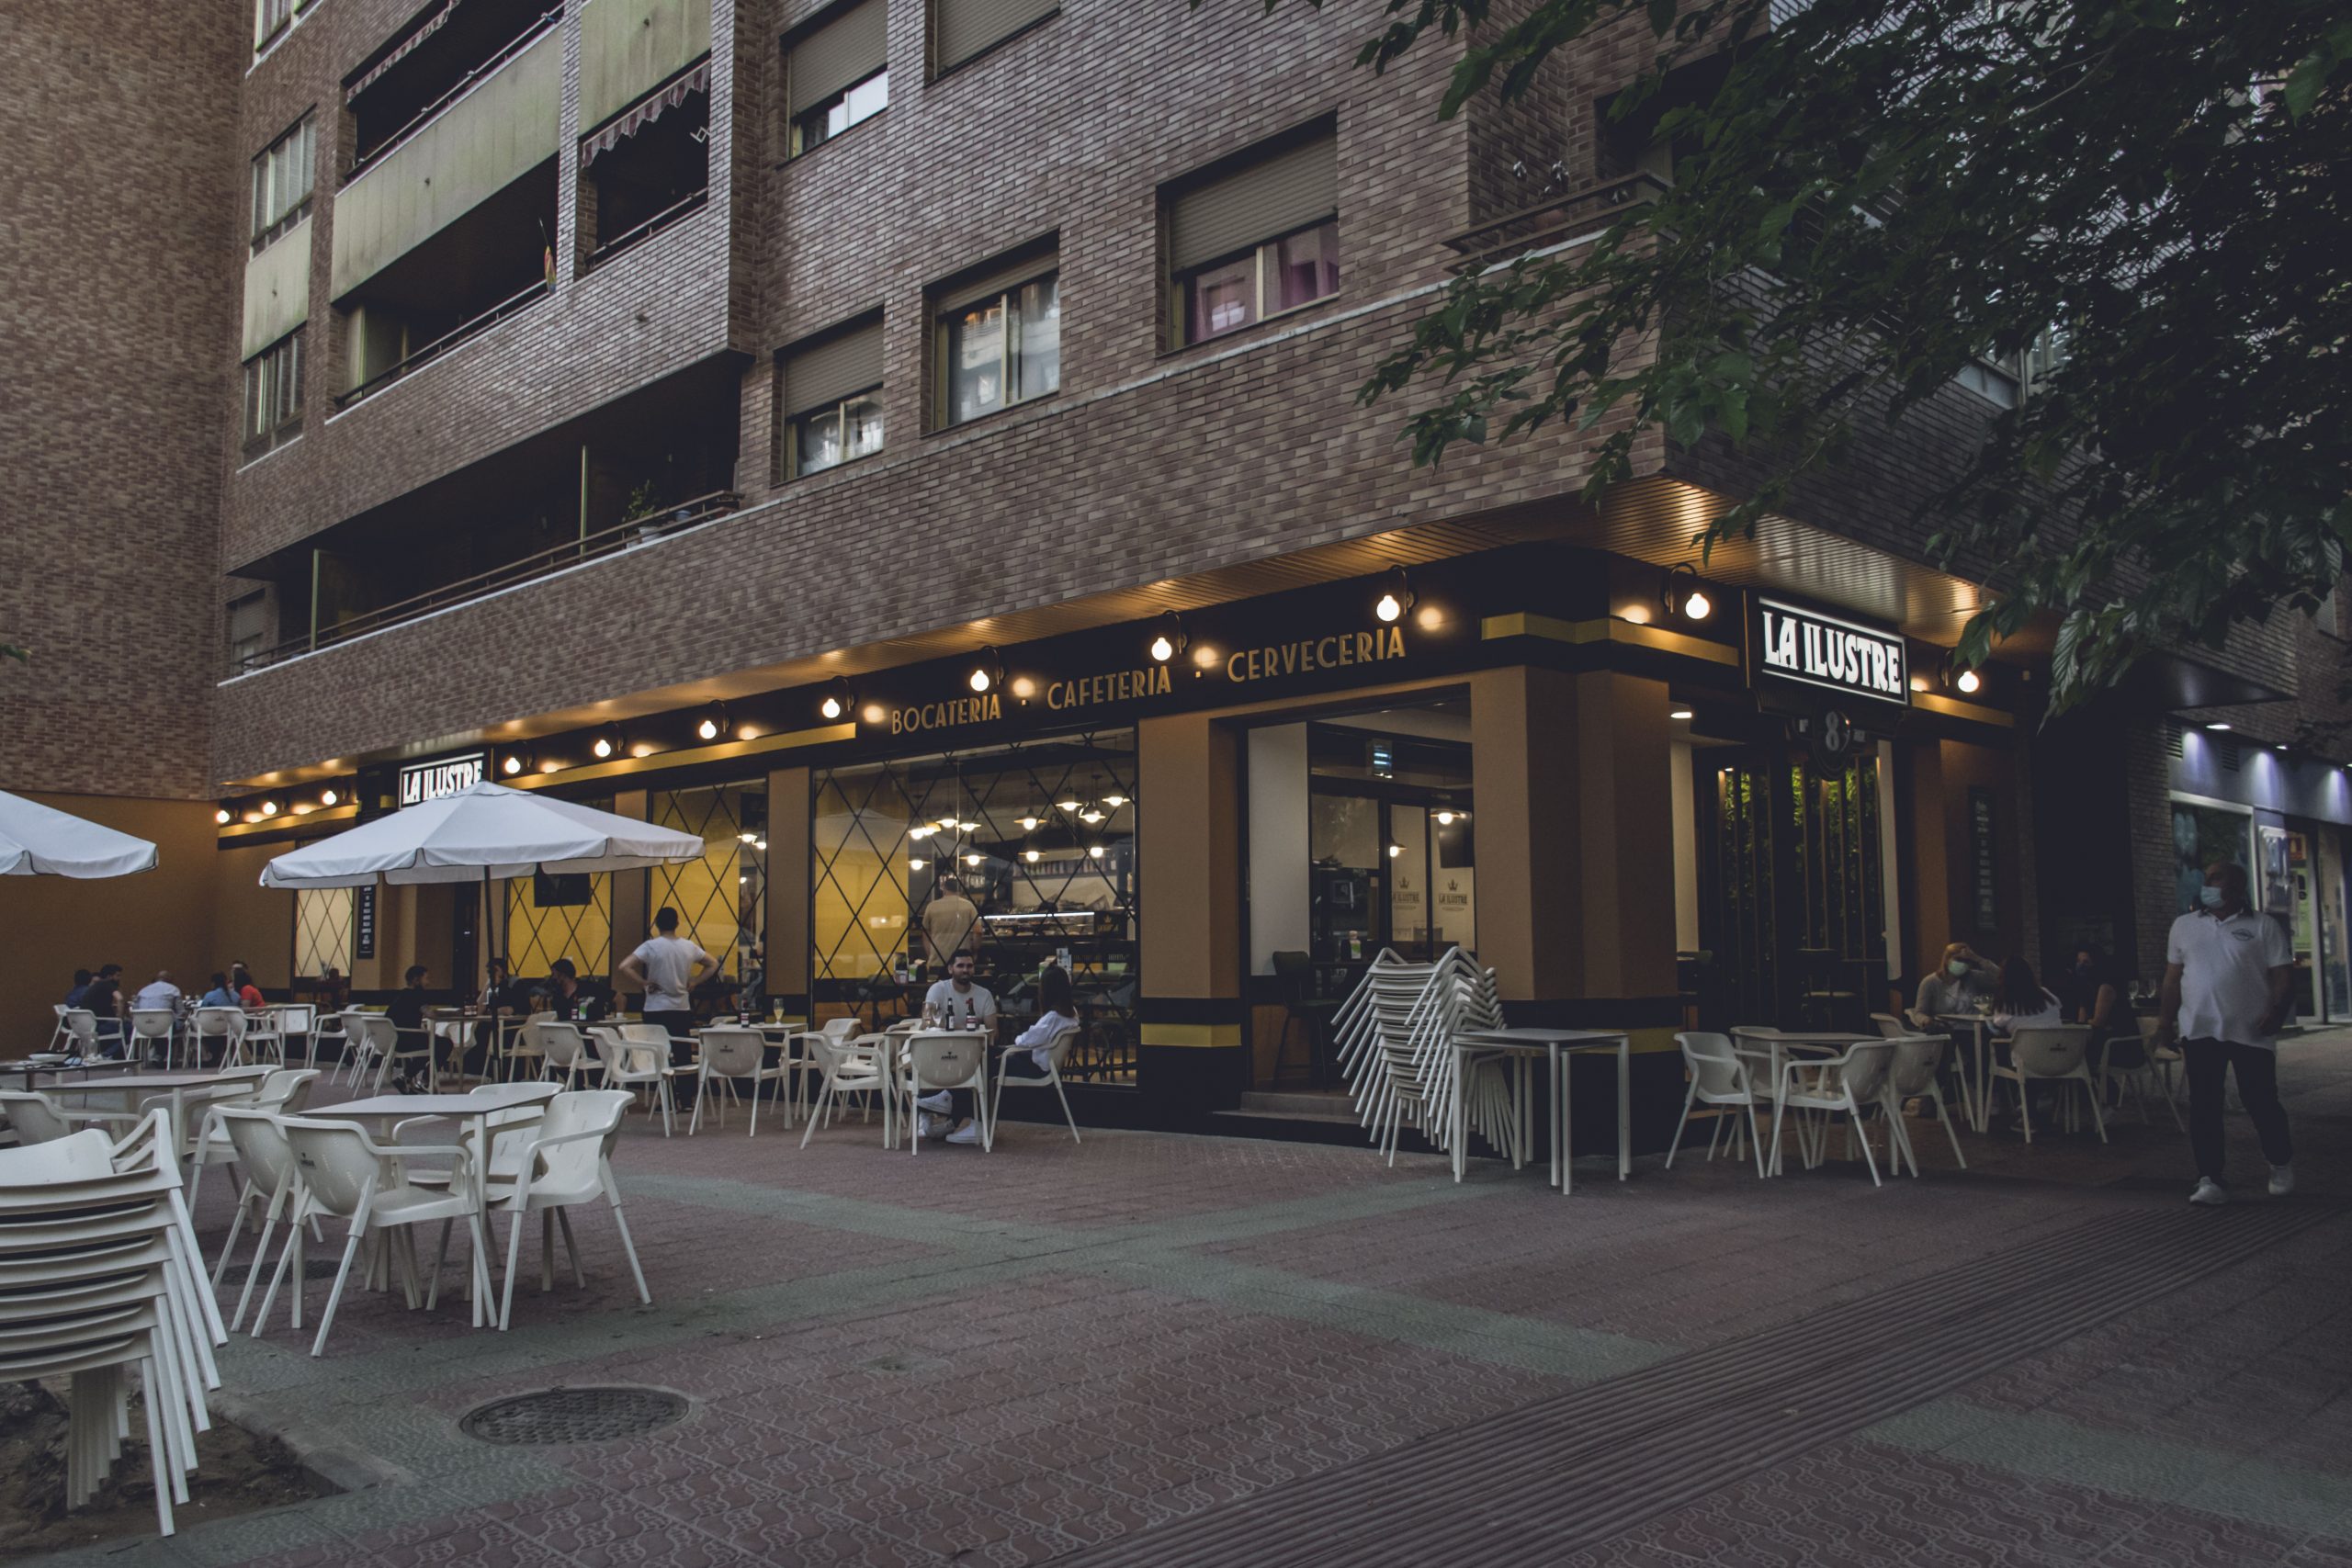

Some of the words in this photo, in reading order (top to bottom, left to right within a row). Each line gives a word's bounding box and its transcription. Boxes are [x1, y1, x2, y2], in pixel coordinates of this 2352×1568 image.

[891, 694, 1001, 735] BOCATERIA
[1046, 664, 1171, 710] CAFETERIA
[1227, 626, 1407, 682] CERVECERIA
[1762, 611, 1799, 671] LA
[1803, 621, 1902, 694] ILUSTRE
[402, 772, 422, 804] LA
[423, 760, 482, 801] ILUSTRE
